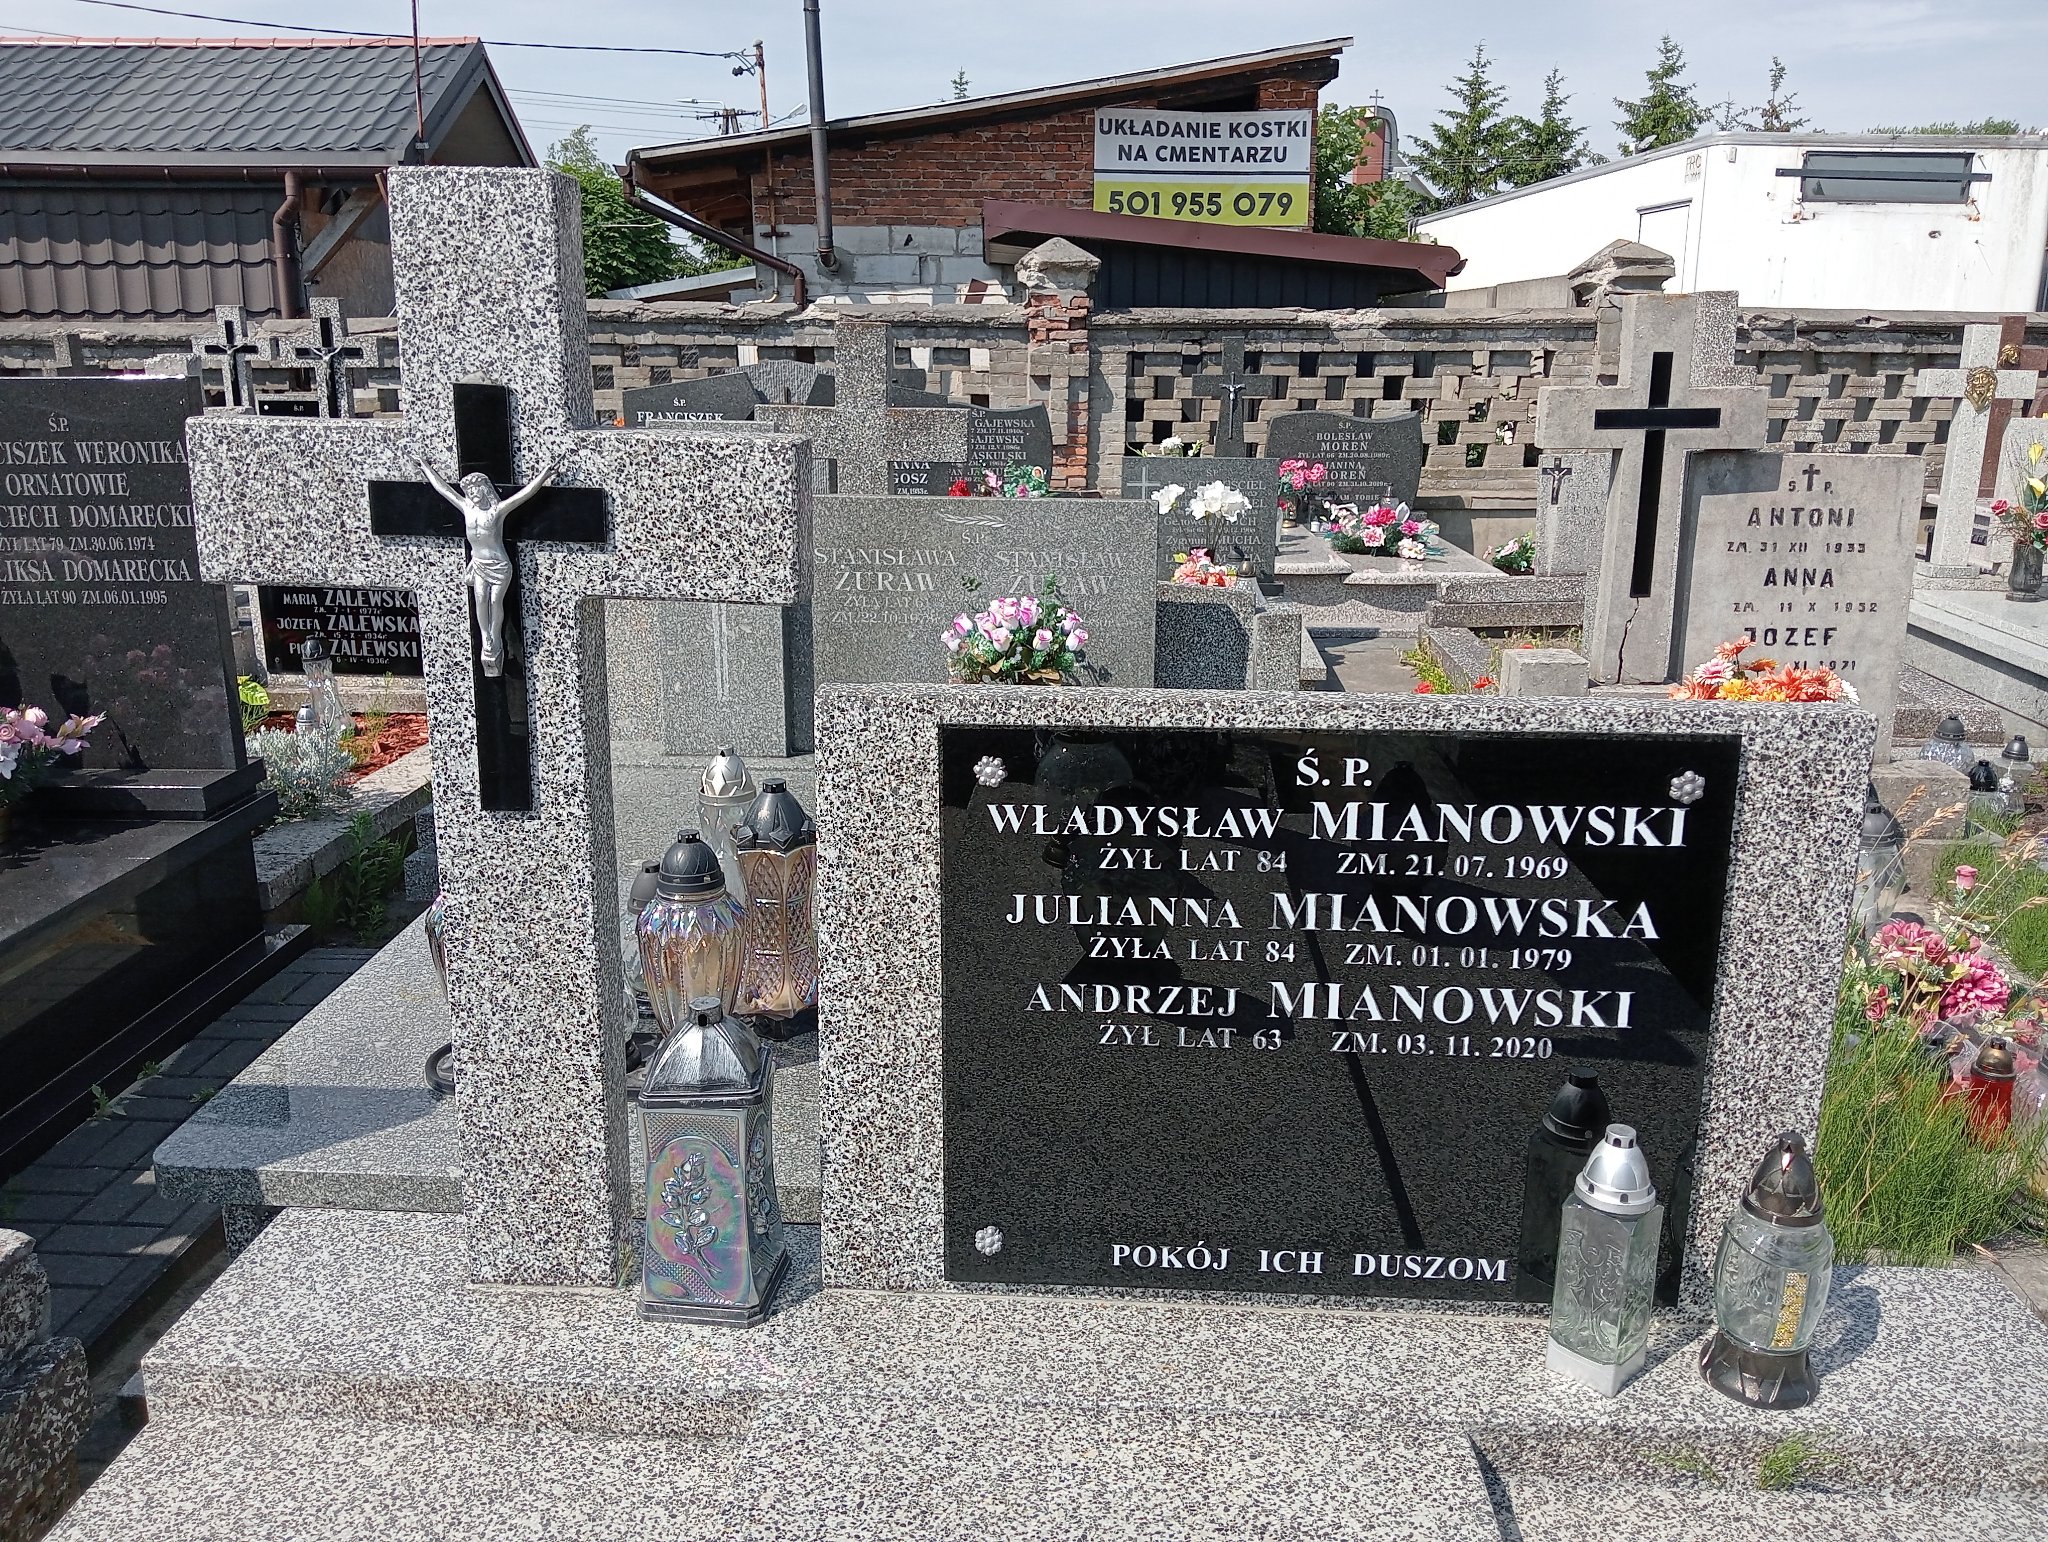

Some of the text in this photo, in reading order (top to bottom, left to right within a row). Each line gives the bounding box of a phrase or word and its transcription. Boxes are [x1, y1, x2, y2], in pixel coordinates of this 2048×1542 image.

[1100, 118, 1307, 139] UKŁADANIE KOSTKI
[1118, 145, 1287, 163] NA CMENTARZU
[1109, 191, 1293, 216] 501 955 079
[49, 412, 70, 432] Ś.P.
[637, 412, 724, 422] FRANCISZEK
[974, 419, 1036, 428] GAJEWSKA
[74, 440, 188, 465] WERONIKA
[1324, 461, 1362, 470] JANINA
[6, 471, 130, 496] ORNATOWIE
[68, 505, 194, 528] DOMARECKI
[1747, 507, 1855, 527] ANTONI
[813, 547, 957, 566] STANISŁAWA
[1727, 541, 1866, 553] ZM. 31 XII 1933
[62, 558, 194, 582] DOMARECKA
[835, 564, 938, 592] ŻURAW
[1764, 567, 1834, 588] ANNA
[61, 590, 77, 605] 90
[284, 589, 418, 608] MARIA ZALEWSKA
[1733, 602, 1760, 613] ZM.
[1780, 602, 1794, 613] 11
[1808, 602, 1817, 613] X
[277, 615, 420, 633] JÓZEFA ZALEWSKA
[328, 639, 418, 657] ZALEWSKI
[1296, 748, 1373, 788] Ś. P.
[986, 801, 1691, 848] WŁADYSŁAW MIANOWSKI
[1099, 842, 1569, 880] ŻYŁ LAT 84 ZM. 21. 07. 1969
[1005, 892, 1660, 940] JULIANNA MIANOWSKA
[1089, 931, 1573, 971] ŻYŁA LAT 84 ZM. 01. 01. 1979
[1024, 980, 1636, 1029] ANDRZEJ MIANOWSKI
[1099, 1018, 1553, 1060] ŻYŁ LAT 63 ZM. 03. 11. 2020
[1111, 1240, 1508, 1283] POKÓJ ICH DUSZOM
